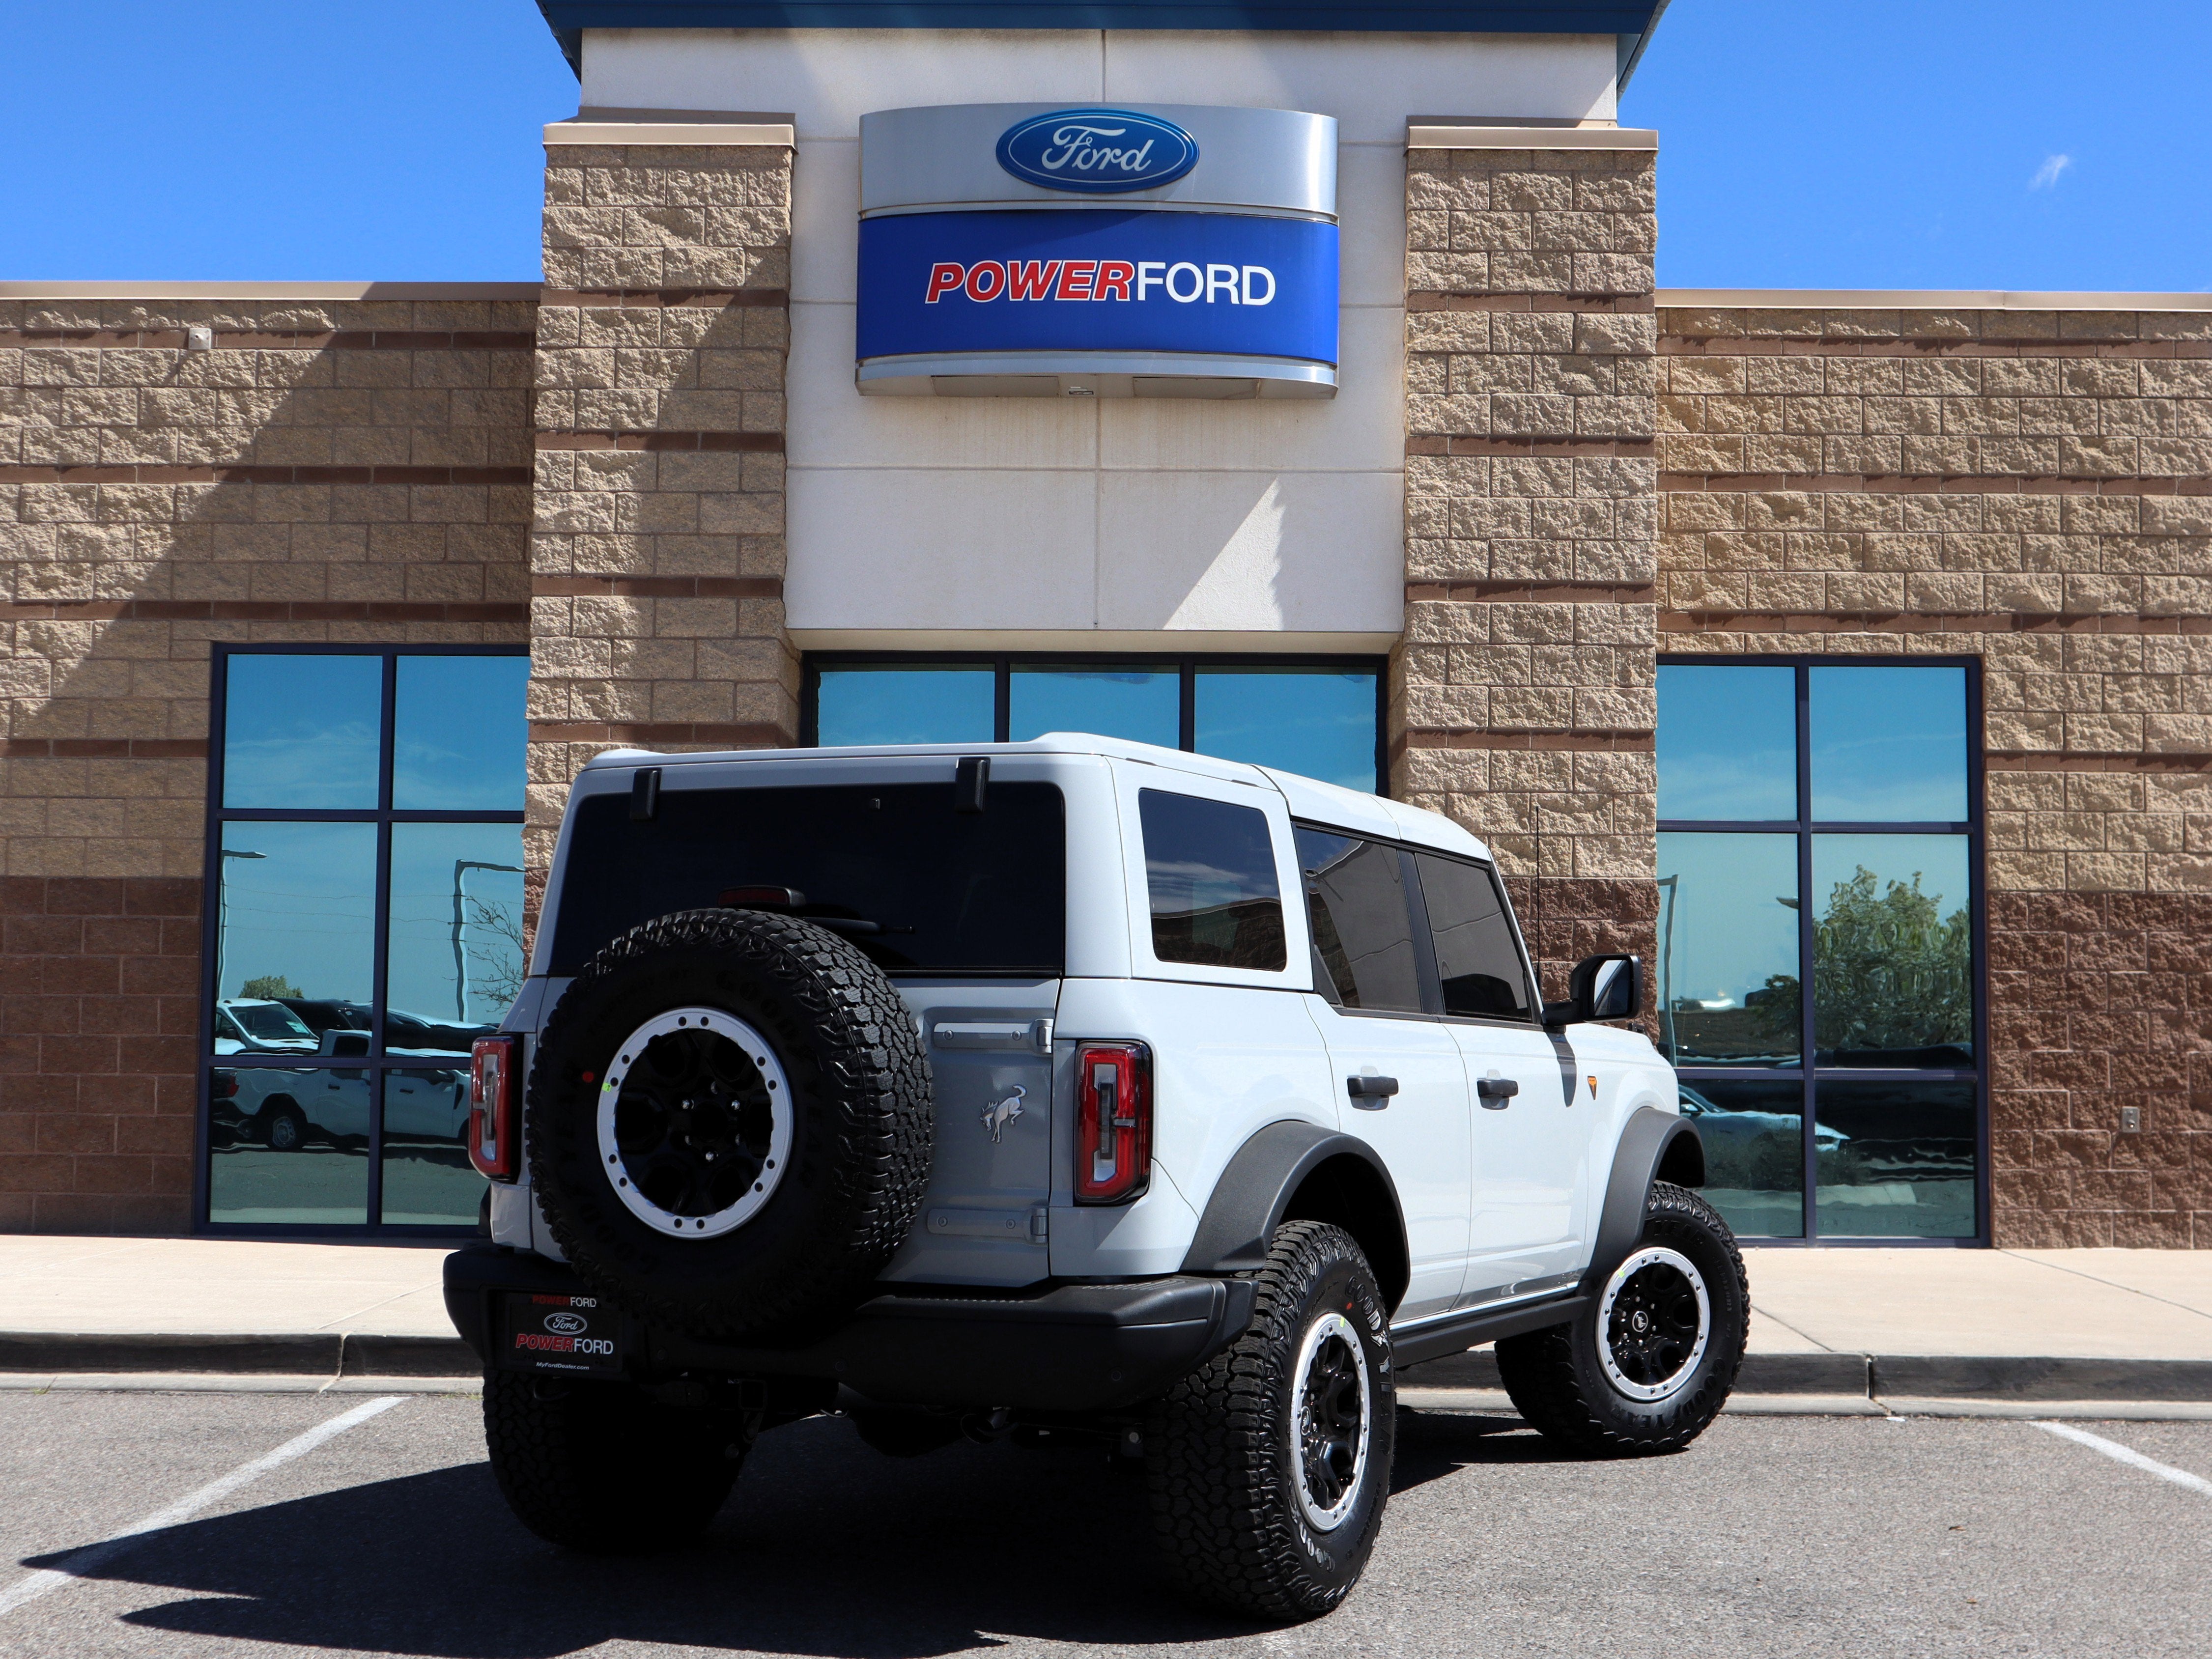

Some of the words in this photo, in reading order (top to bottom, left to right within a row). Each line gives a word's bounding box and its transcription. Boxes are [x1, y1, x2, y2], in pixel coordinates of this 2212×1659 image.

[1041, 124, 1154, 172] Ford
[925, 260, 1276, 306] POWERFORD
[552, 1317, 579, 1330] Ford
[515, 1334, 614, 1355] POWERFORD
